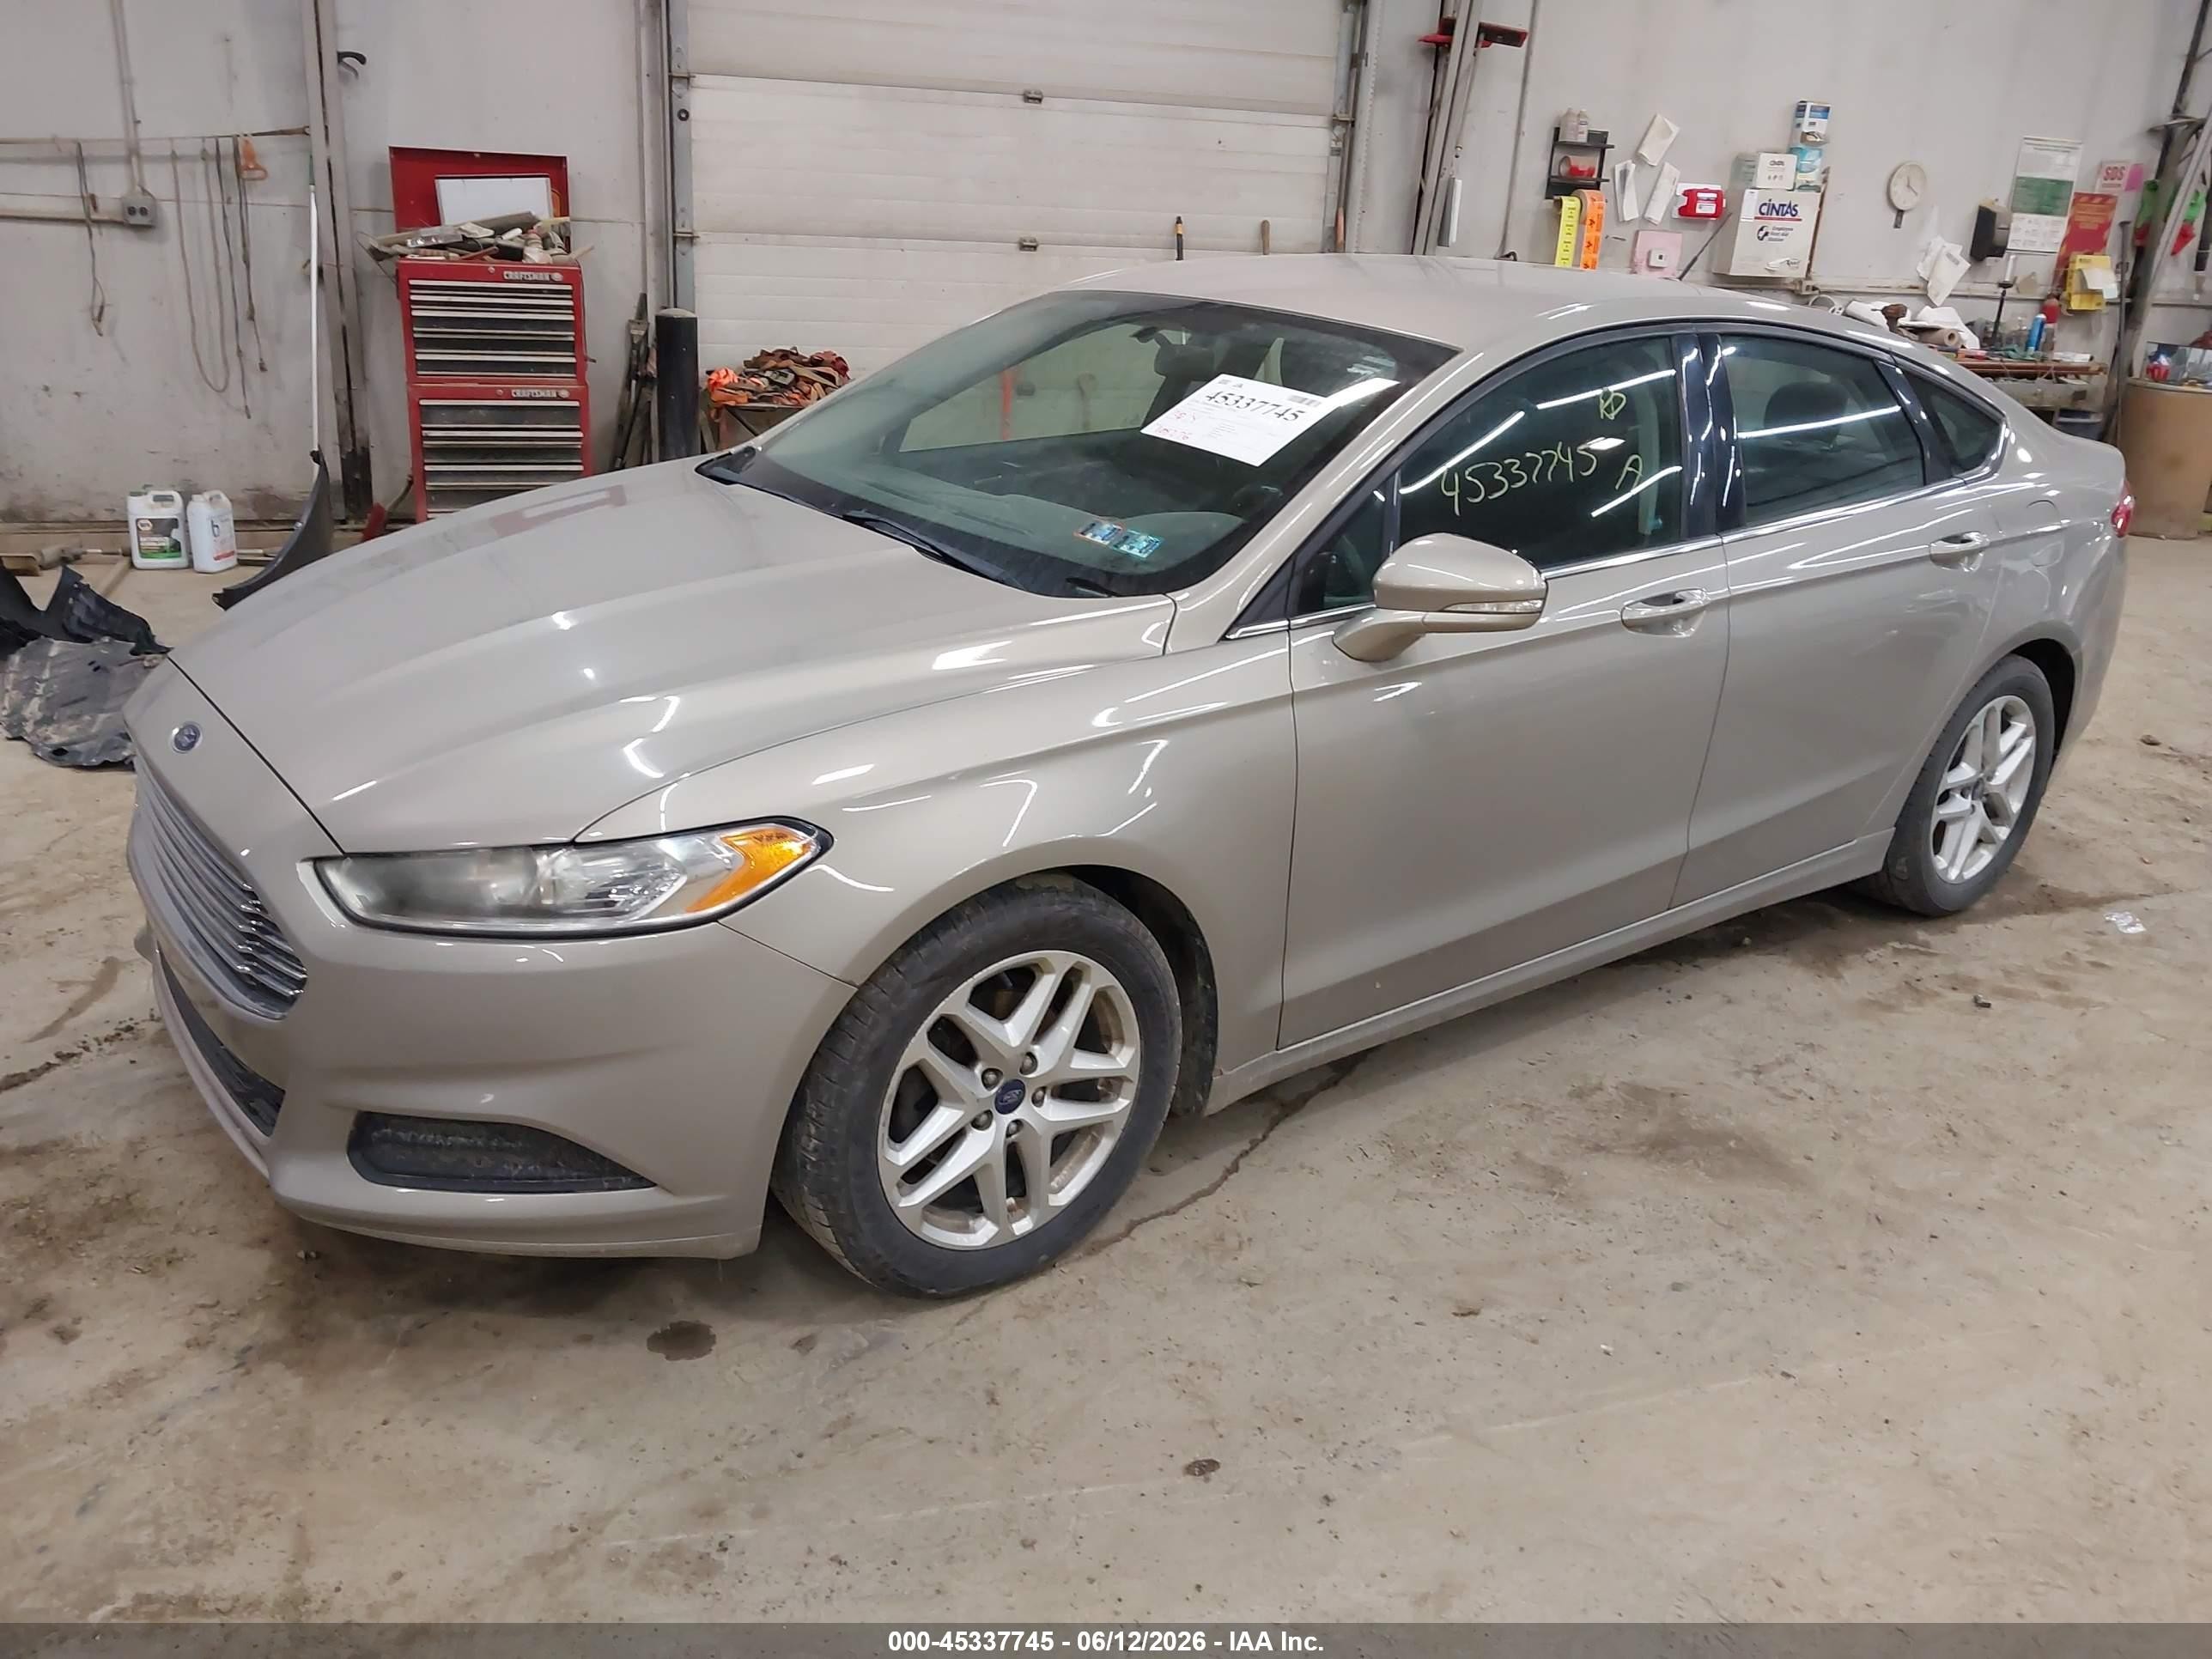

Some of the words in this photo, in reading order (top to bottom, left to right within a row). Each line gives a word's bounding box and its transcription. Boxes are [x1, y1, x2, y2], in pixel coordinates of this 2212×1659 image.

[2104, 166, 2125, 180] SDS
[1206, 391, 1306, 422] 45337745
[1441, 441, 1598, 516] 45337745
[1614, 454, 1643, 492] A
